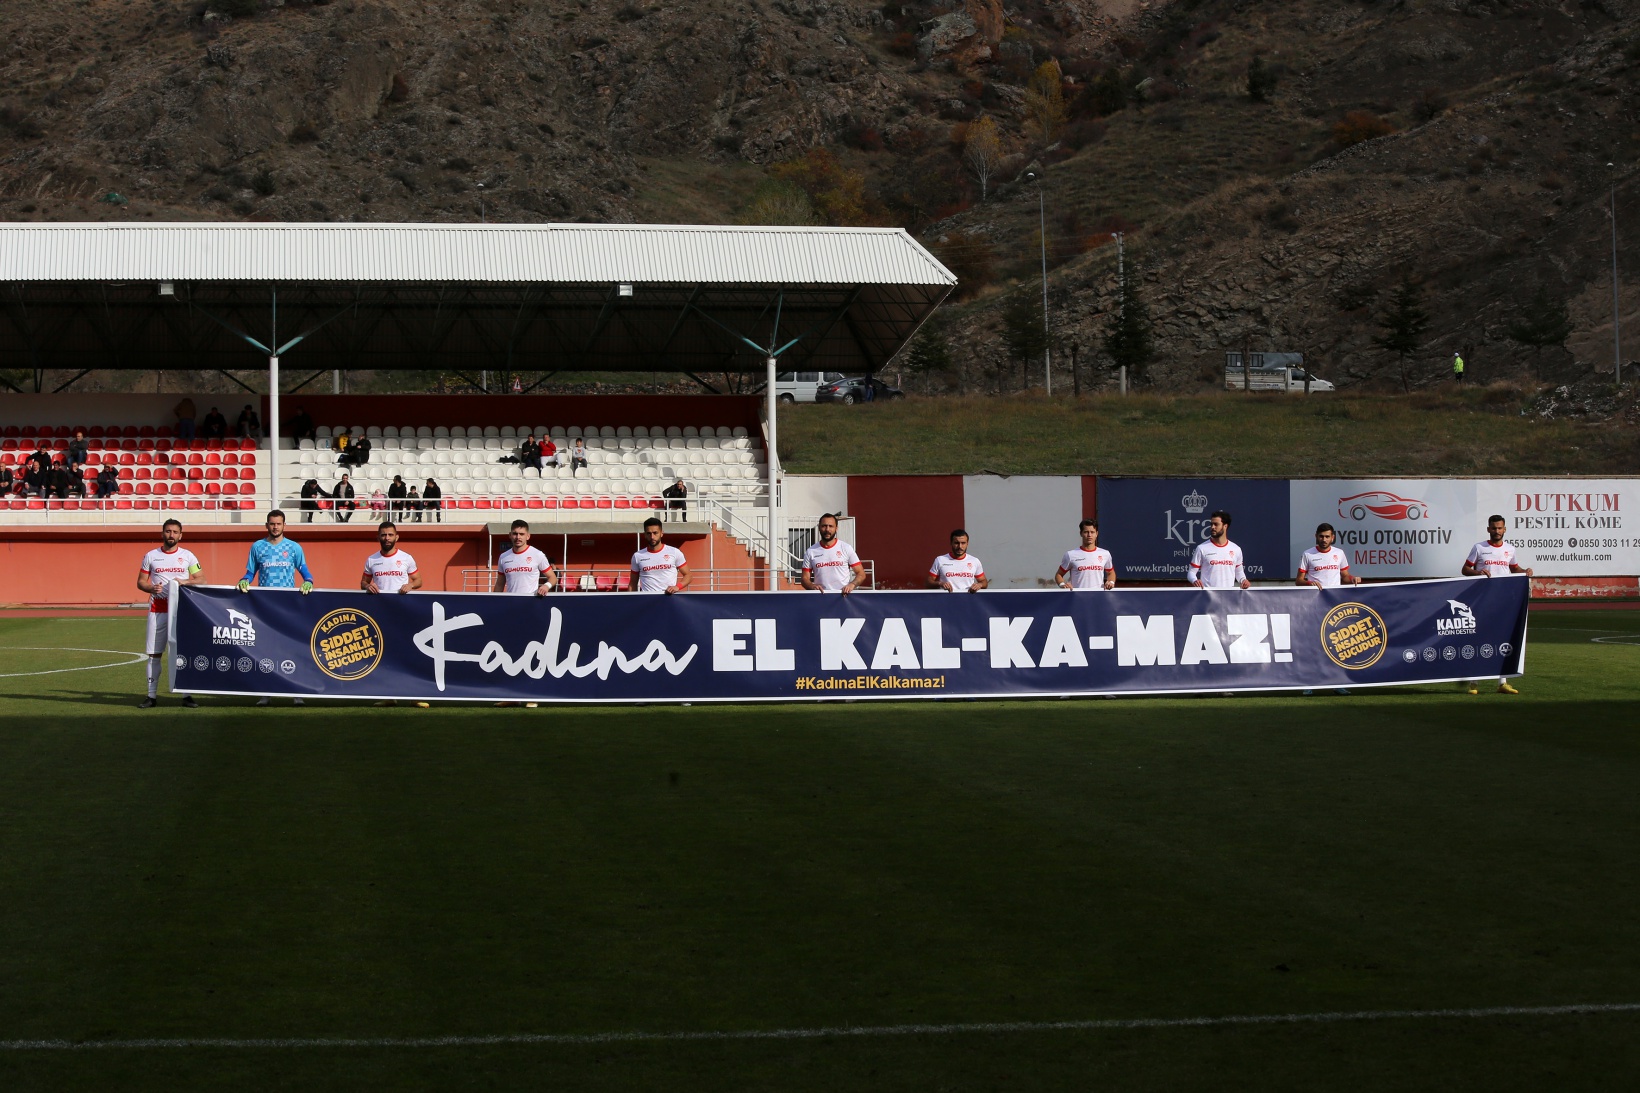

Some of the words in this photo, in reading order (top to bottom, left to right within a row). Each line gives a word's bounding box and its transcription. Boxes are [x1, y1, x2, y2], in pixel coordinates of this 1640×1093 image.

[1515, 493, 1620, 512] DUTKUM
[1164, 509, 1212, 547] kra
[1514, 513, 1570, 529] PESTİL
[1575, 513, 1622, 529] KÖME
[1316, 530, 1368, 545] YGU
[1374, 527, 1452, 545] OTOMOTİV
[1528, 539, 1563, 548] 0950029
[1580, 539, 1599, 548] 0850
[1602, 539, 1618, 548] 303
[1621, 539, 1630, 548] 11
[1354, 547, 1413, 565] MERSİN
[1535, 552, 1612, 562] www.dutkum.com
[1247, 565, 1264, 574] 074
[321, 613, 357, 632] KADINA
[1328, 607, 1360, 626] KADINA
[1436, 617, 1476, 630] KADES
[212, 626, 256, 641] KADES
[232, 639, 256, 647] DESTEK
[413, 601, 698, 692] Kadına
[712, 618, 795, 671] EL
[819, 613, 1294, 671] KAL-KA-MAZ!
[1338, 636, 1382, 661] SUÇUDUR
[327, 647, 377, 670] SUÇUDUR
[795, 674, 945, 690] #KadınaElKalkamaz!
